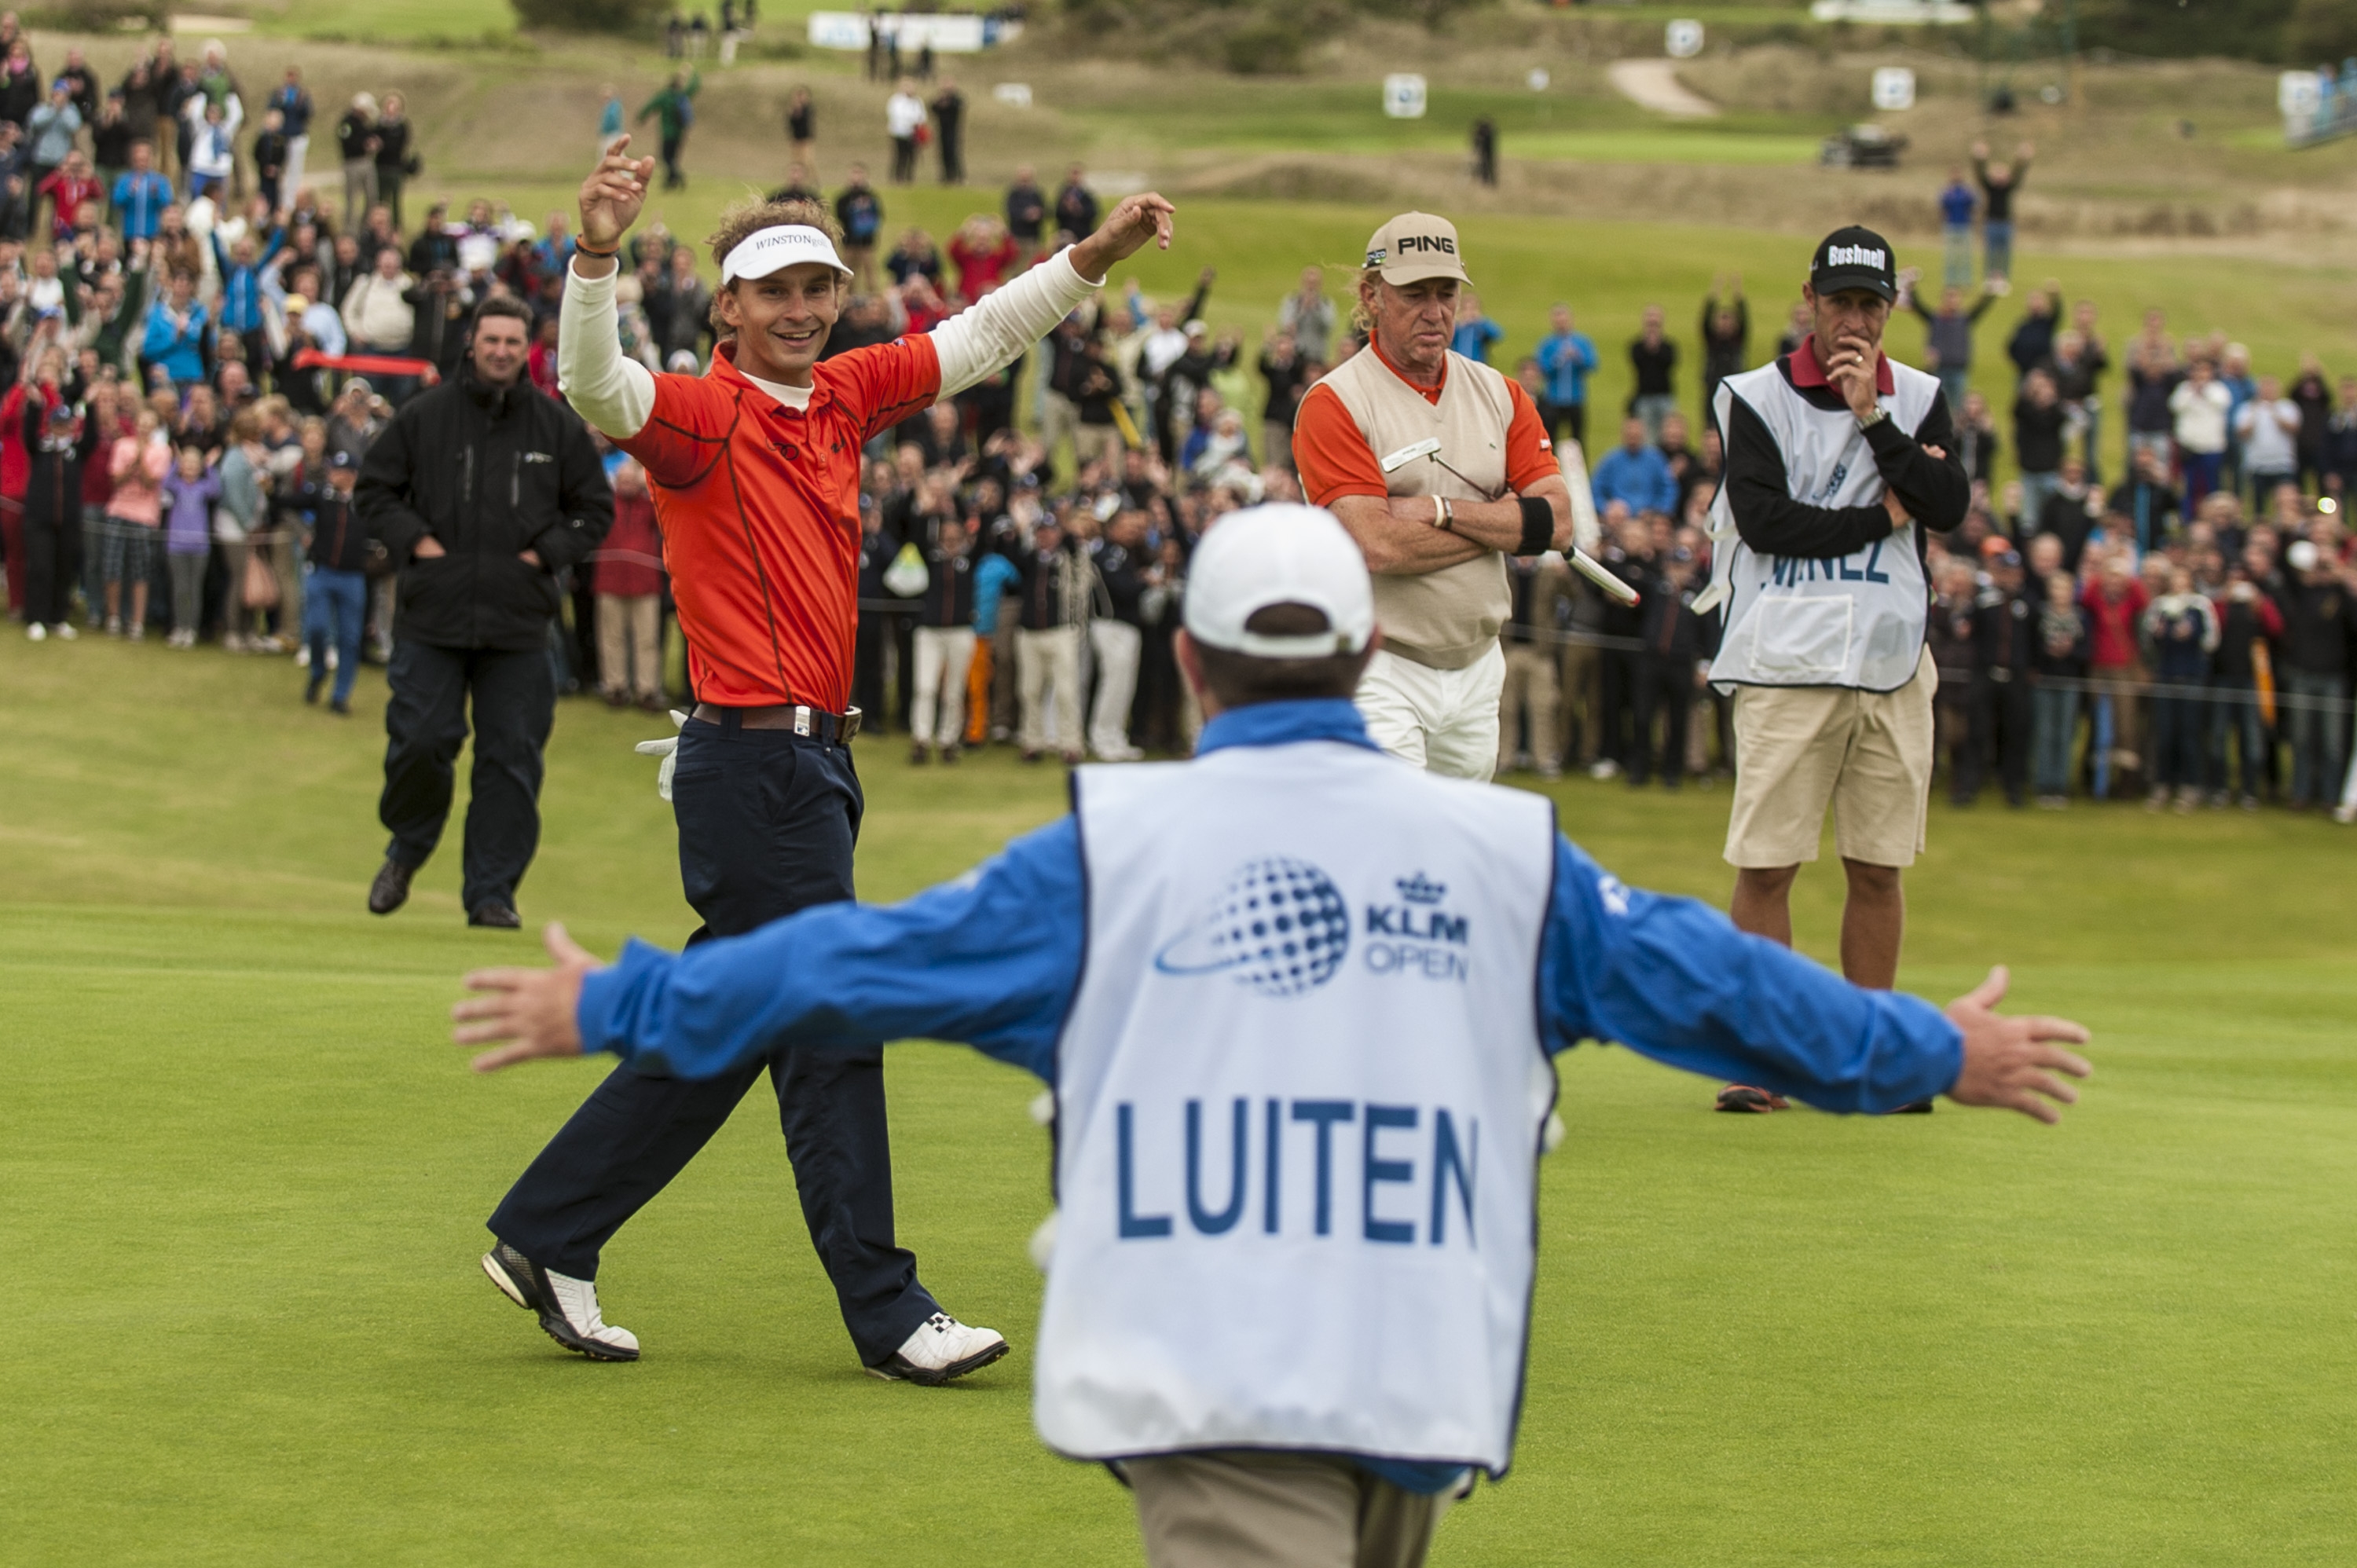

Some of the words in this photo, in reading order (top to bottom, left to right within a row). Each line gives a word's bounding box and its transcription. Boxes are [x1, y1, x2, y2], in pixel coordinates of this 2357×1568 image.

[1398, 235, 1455, 255] PING
[1828, 244, 1886, 272] Bushnell
[1367, 905, 1469, 945] KLM
[1364, 942, 1468, 983] OPEN
[1116, 1097, 1477, 1250] LUITEN
